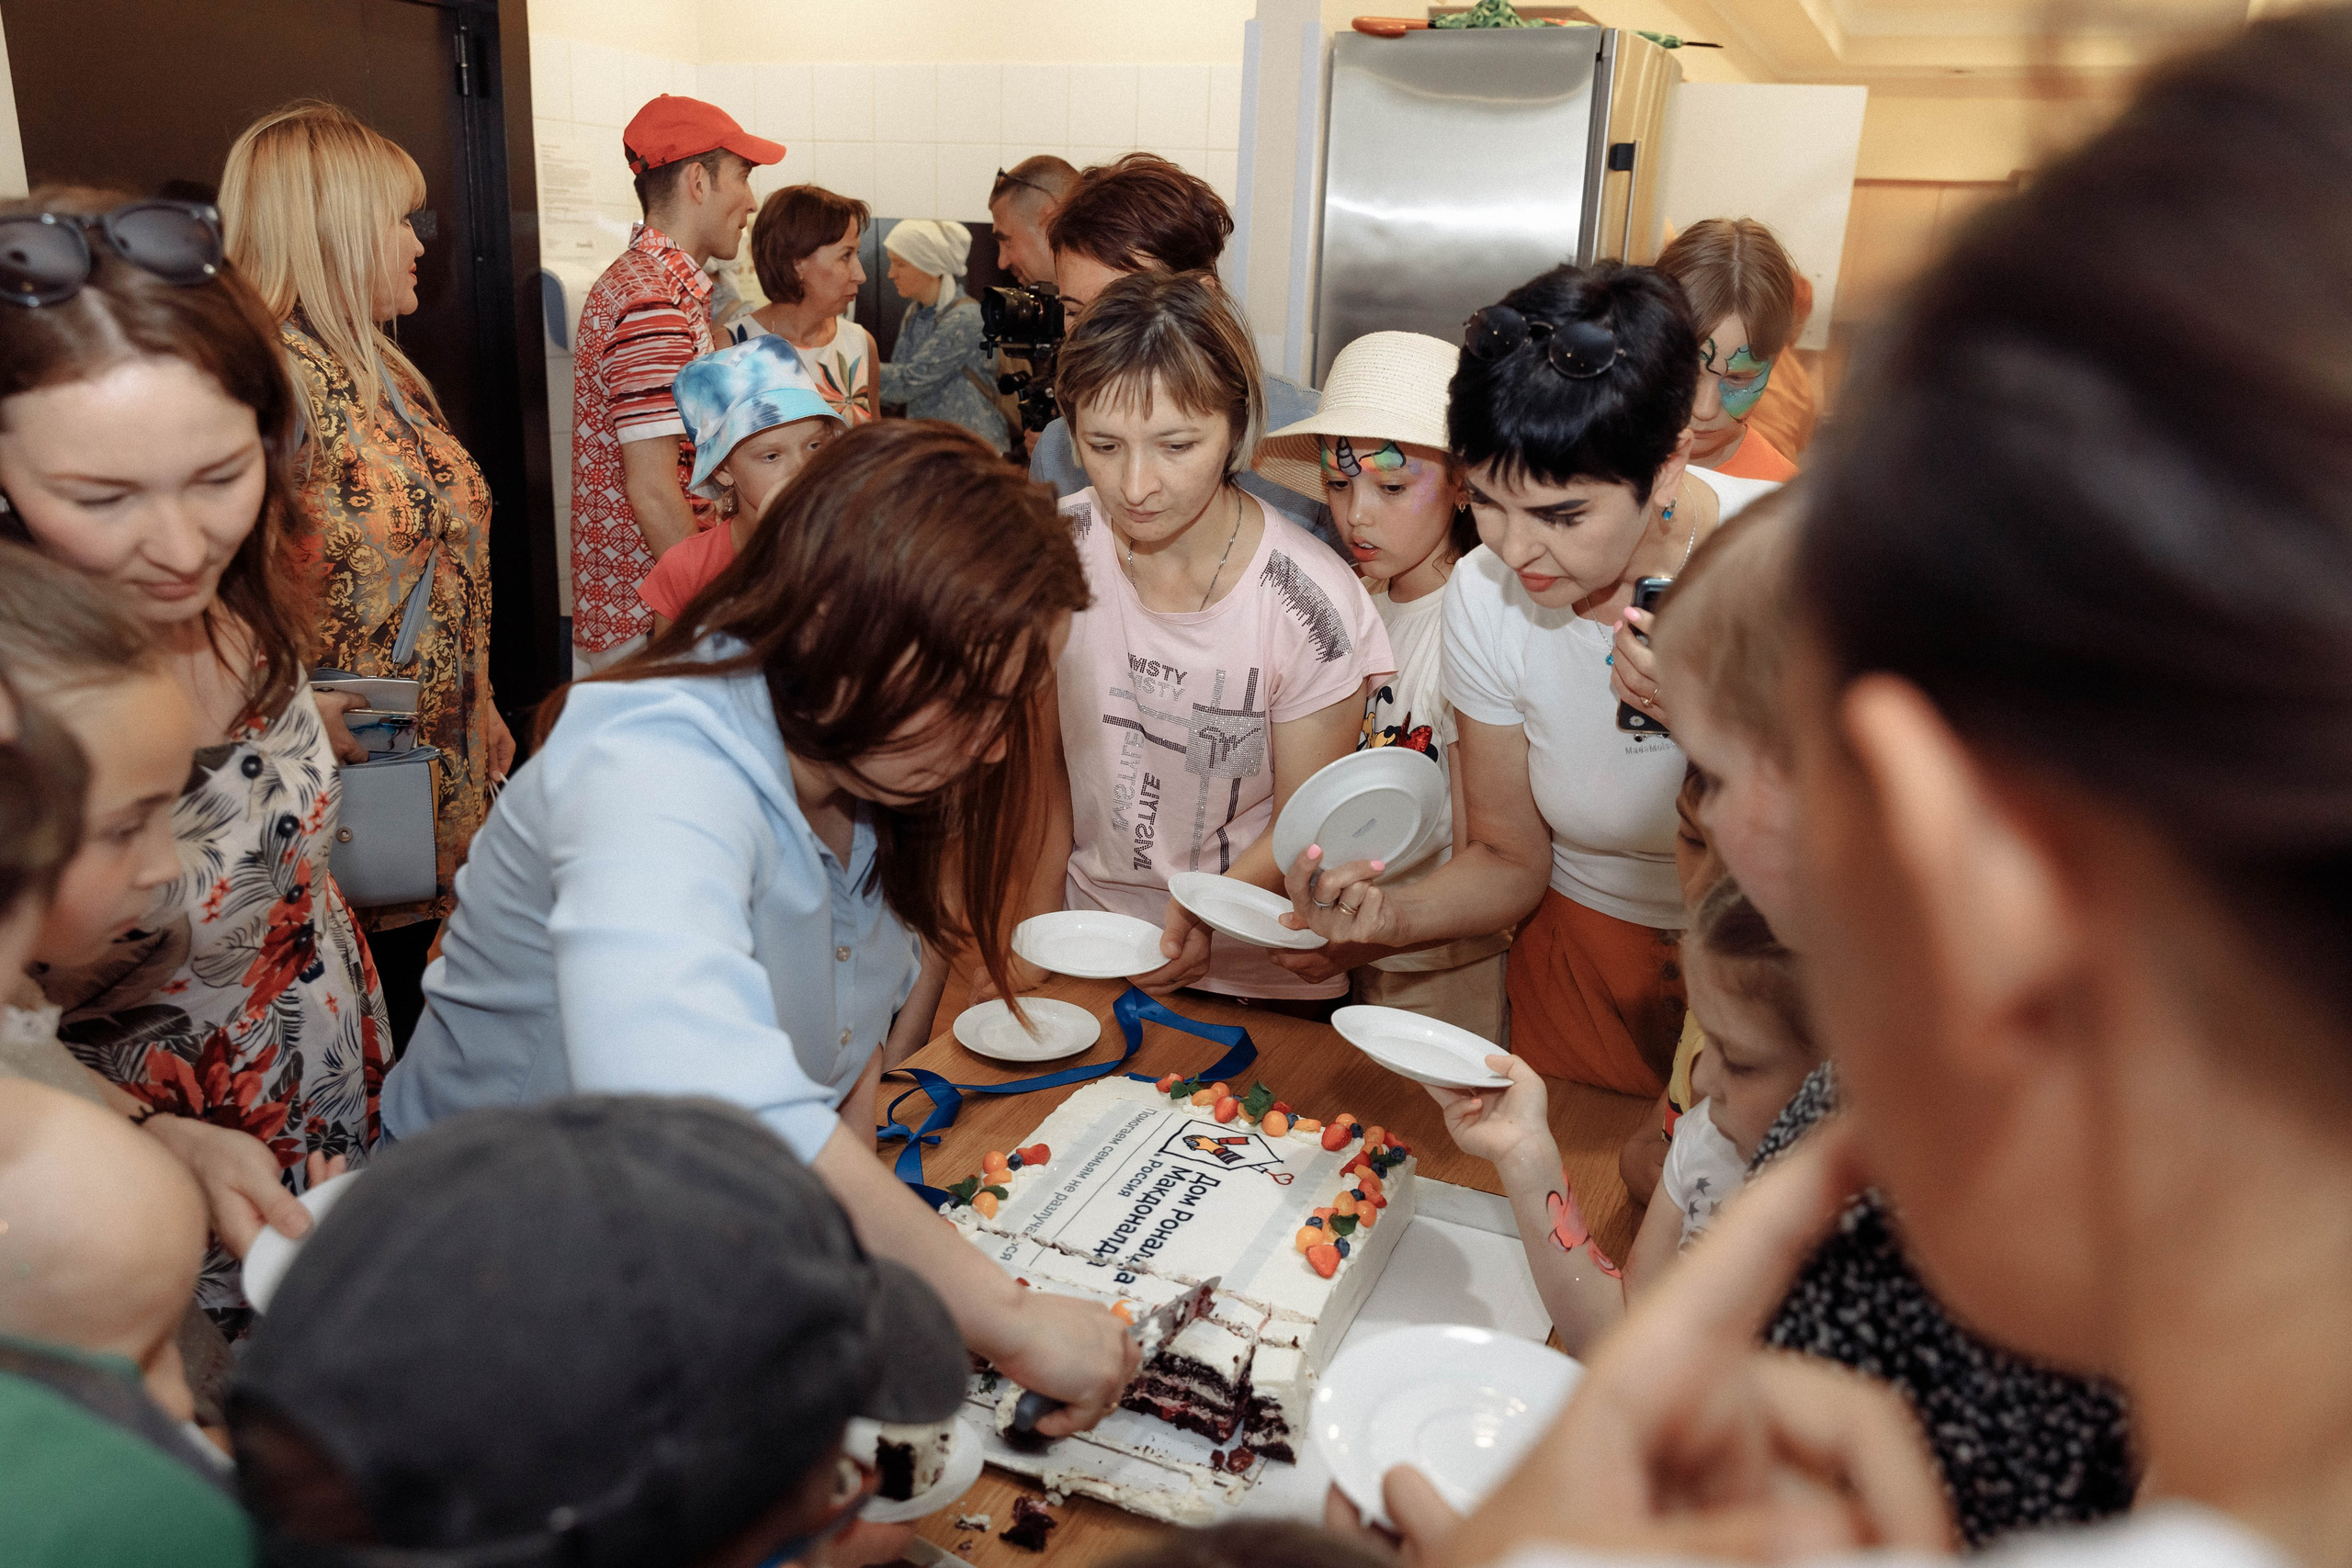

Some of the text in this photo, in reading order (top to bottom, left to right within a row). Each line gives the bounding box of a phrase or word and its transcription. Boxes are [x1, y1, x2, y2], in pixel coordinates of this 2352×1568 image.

[1000, 1108, 1158, 1261] Помогаем семьям не разлучася
[1114, 1171, 1221, 1284] Дом Ронала
[1117, 1159, 1164, 1198] Россия
